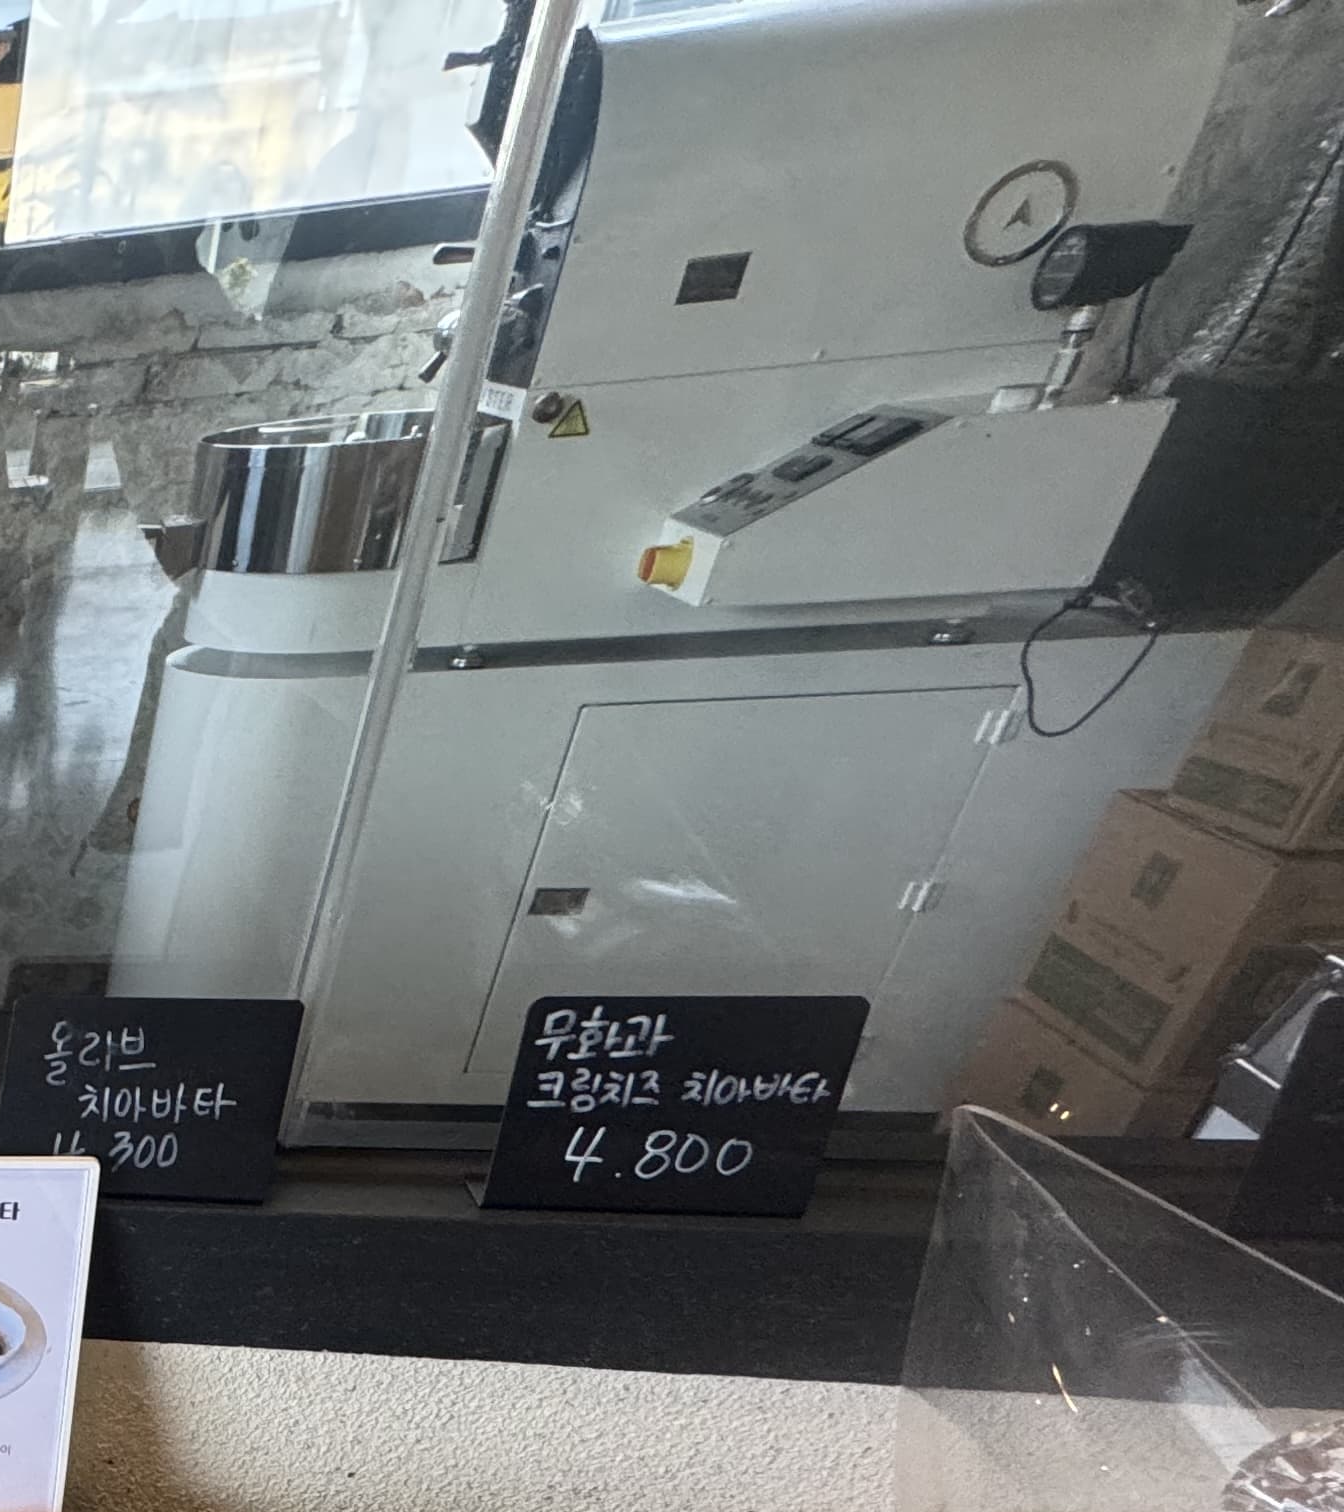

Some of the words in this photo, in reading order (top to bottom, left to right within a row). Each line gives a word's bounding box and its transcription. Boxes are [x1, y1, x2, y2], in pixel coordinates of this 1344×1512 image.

[44, 1020, 157, 1086] 올리브
[534, 1005, 675, 1062] 무화과
[78, 1082, 238, 1123] 치아바타
[526, 1067, 661, 1113] 크림치즈
[681, 1068, 832, 1106] 치아바타
[564, 1125, 753, 1183] 4.800
